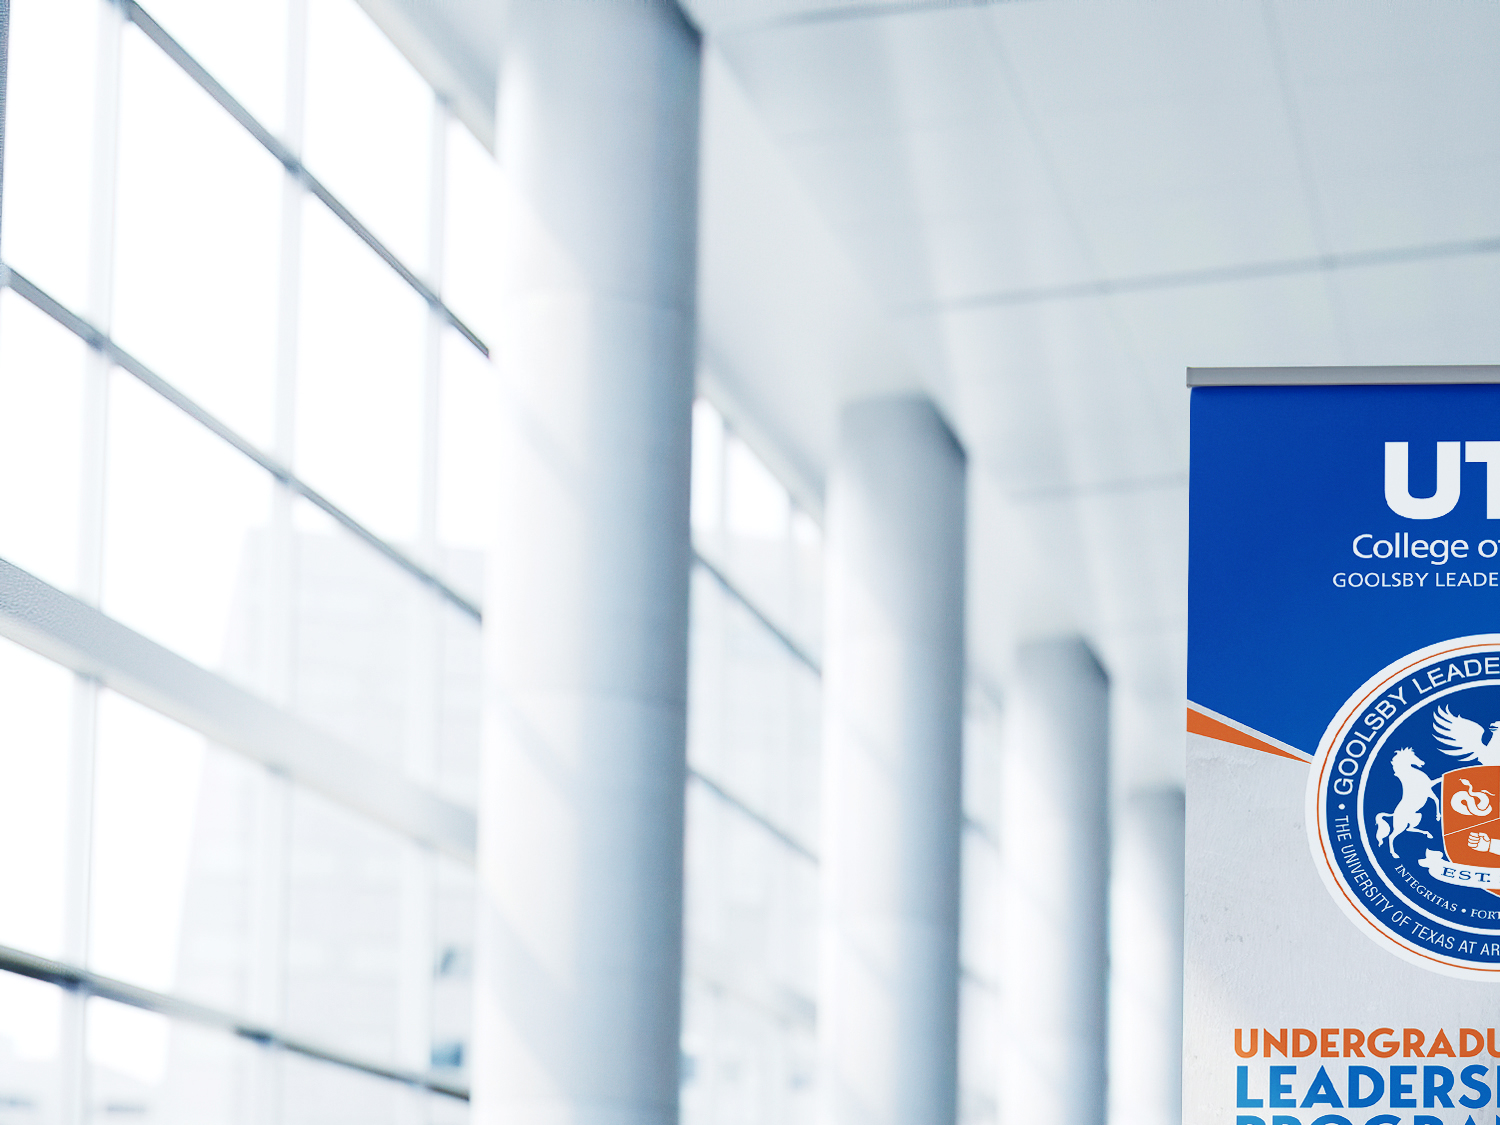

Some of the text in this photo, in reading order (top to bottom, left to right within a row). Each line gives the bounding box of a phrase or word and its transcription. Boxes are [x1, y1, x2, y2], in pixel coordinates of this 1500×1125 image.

[1352, 532, 1469, 565] College
[1332, 571, 1429, 588] GOOLSBY
[1333, 687, 1408, 796] GOOLSBY
[1334, 814, 1350, 843] THE
[1342, 844, 1392, 914] UNIVERSITY
[1391, 911, 1412, 928] OF
[1412, 921, 1455, 951] TEXAS
[1458, 940, 1478, 955] AT
[1394, 863, 1458, 914] INTEGRITAS
[1441, 866, 1490, 883] EST.
